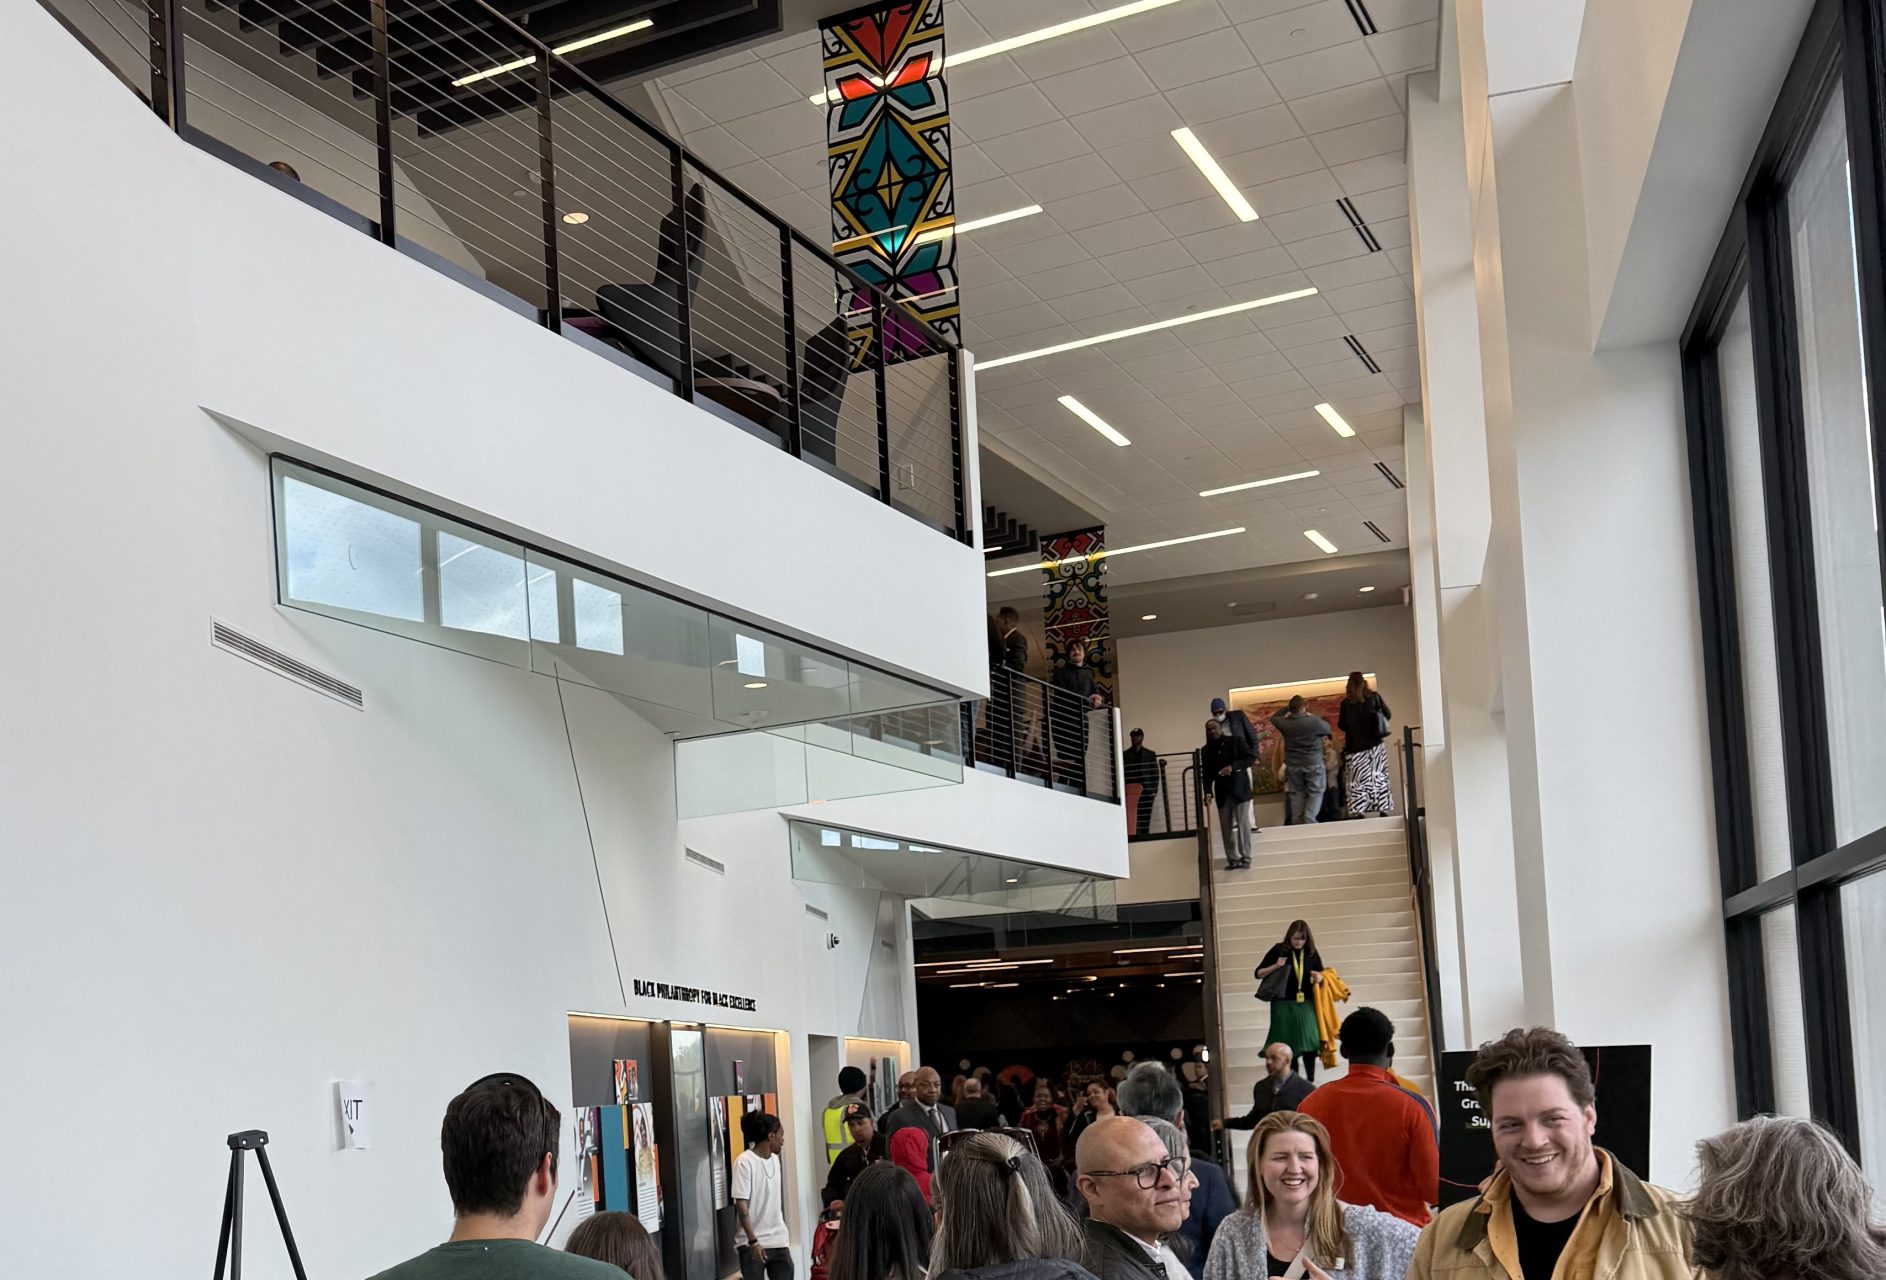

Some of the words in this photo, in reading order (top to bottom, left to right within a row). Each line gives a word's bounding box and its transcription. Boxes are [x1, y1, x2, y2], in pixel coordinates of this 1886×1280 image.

[633, 979, 655, 998] BLACK
[656, 982, 700, 1004] PHILANTHROPY
[701, 990, 712, 1005] FOR
[712, 992, 729, 1008] BLACK
[729, 995, 757, 1012] EXCELLENCE
[344, 1099, 363, 1120] XIT
[1461, 1098, 1481, 1109] Gra
